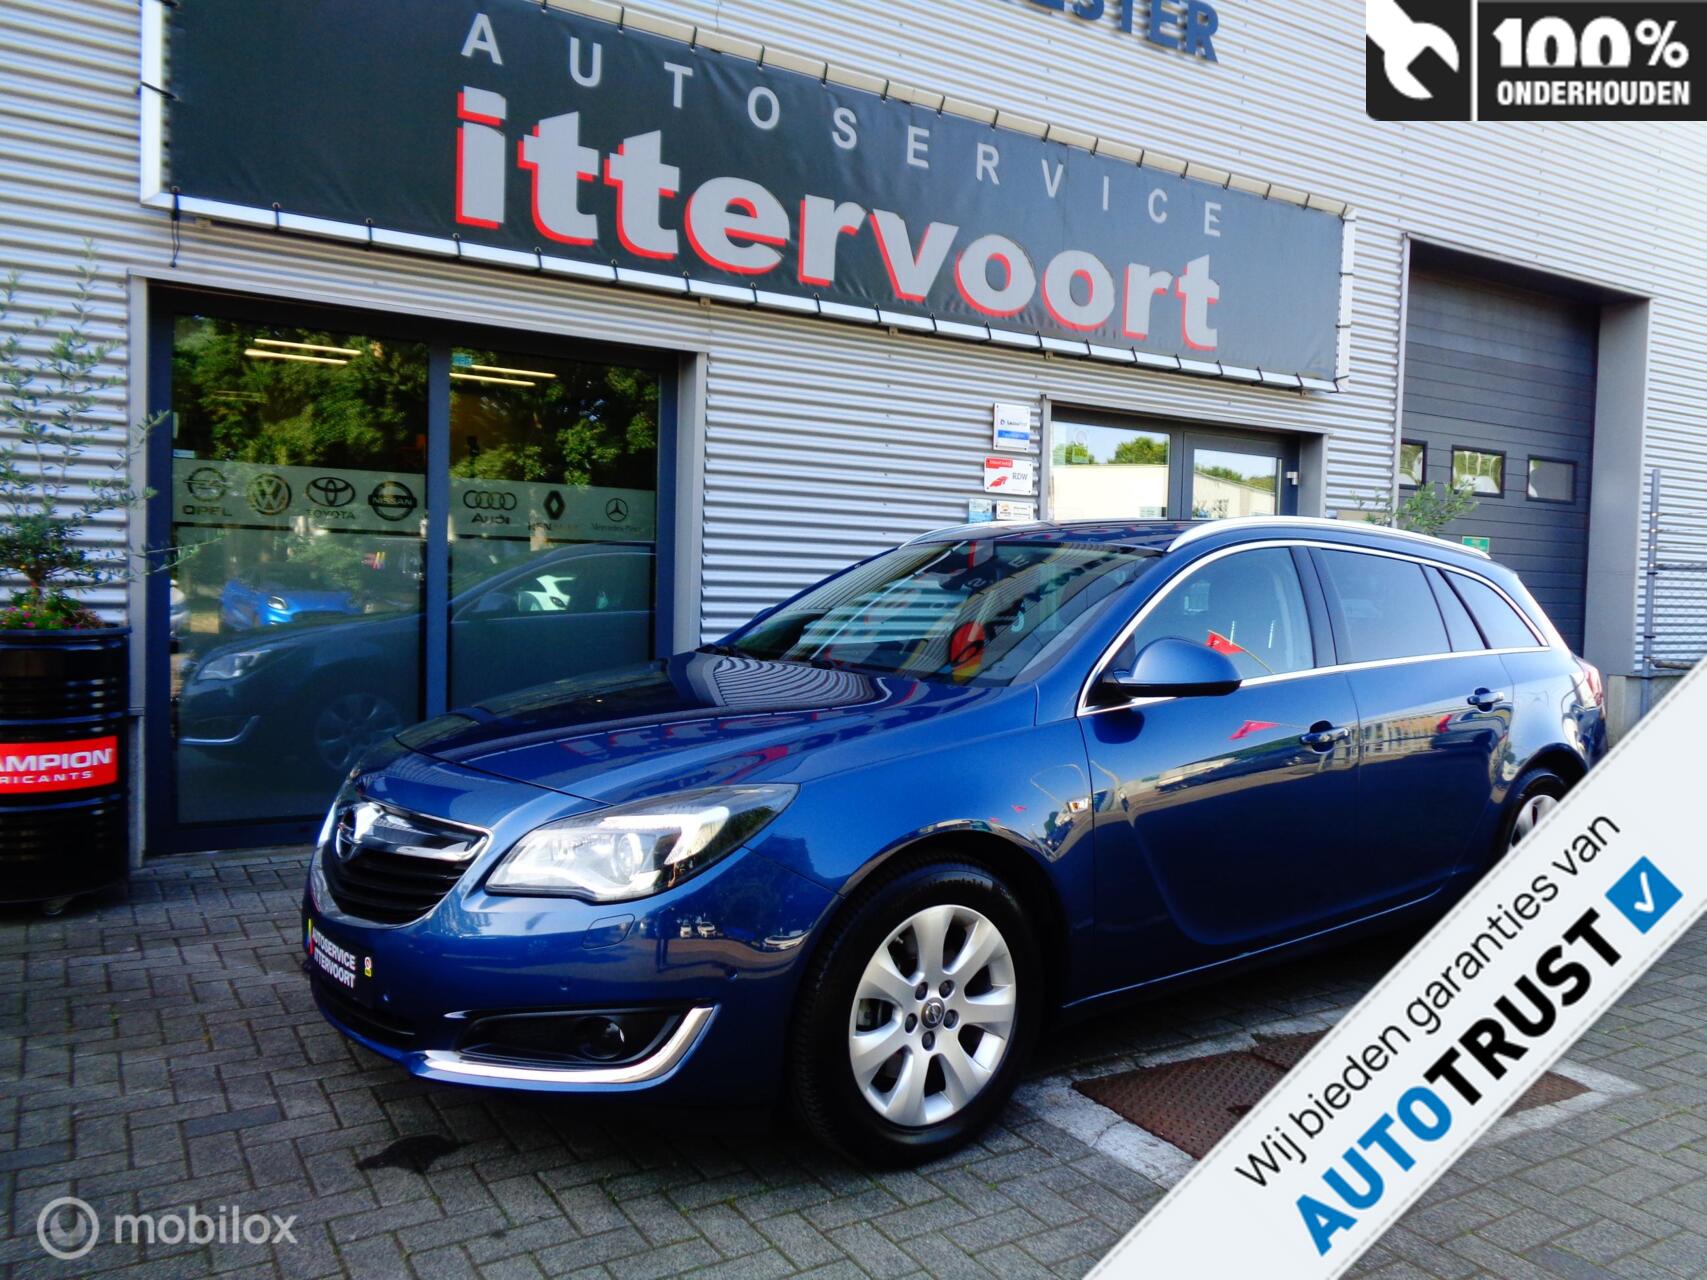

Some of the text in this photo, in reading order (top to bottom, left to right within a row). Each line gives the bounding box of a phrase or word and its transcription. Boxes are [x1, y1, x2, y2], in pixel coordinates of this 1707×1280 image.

[461, 13, 1222, 237] AUTOSERVICE
[456, 86, 1221, 351] ittervoort
[183, 505, 232, 517] OPEL
[306, 509, 356, 520] TOYOTA
